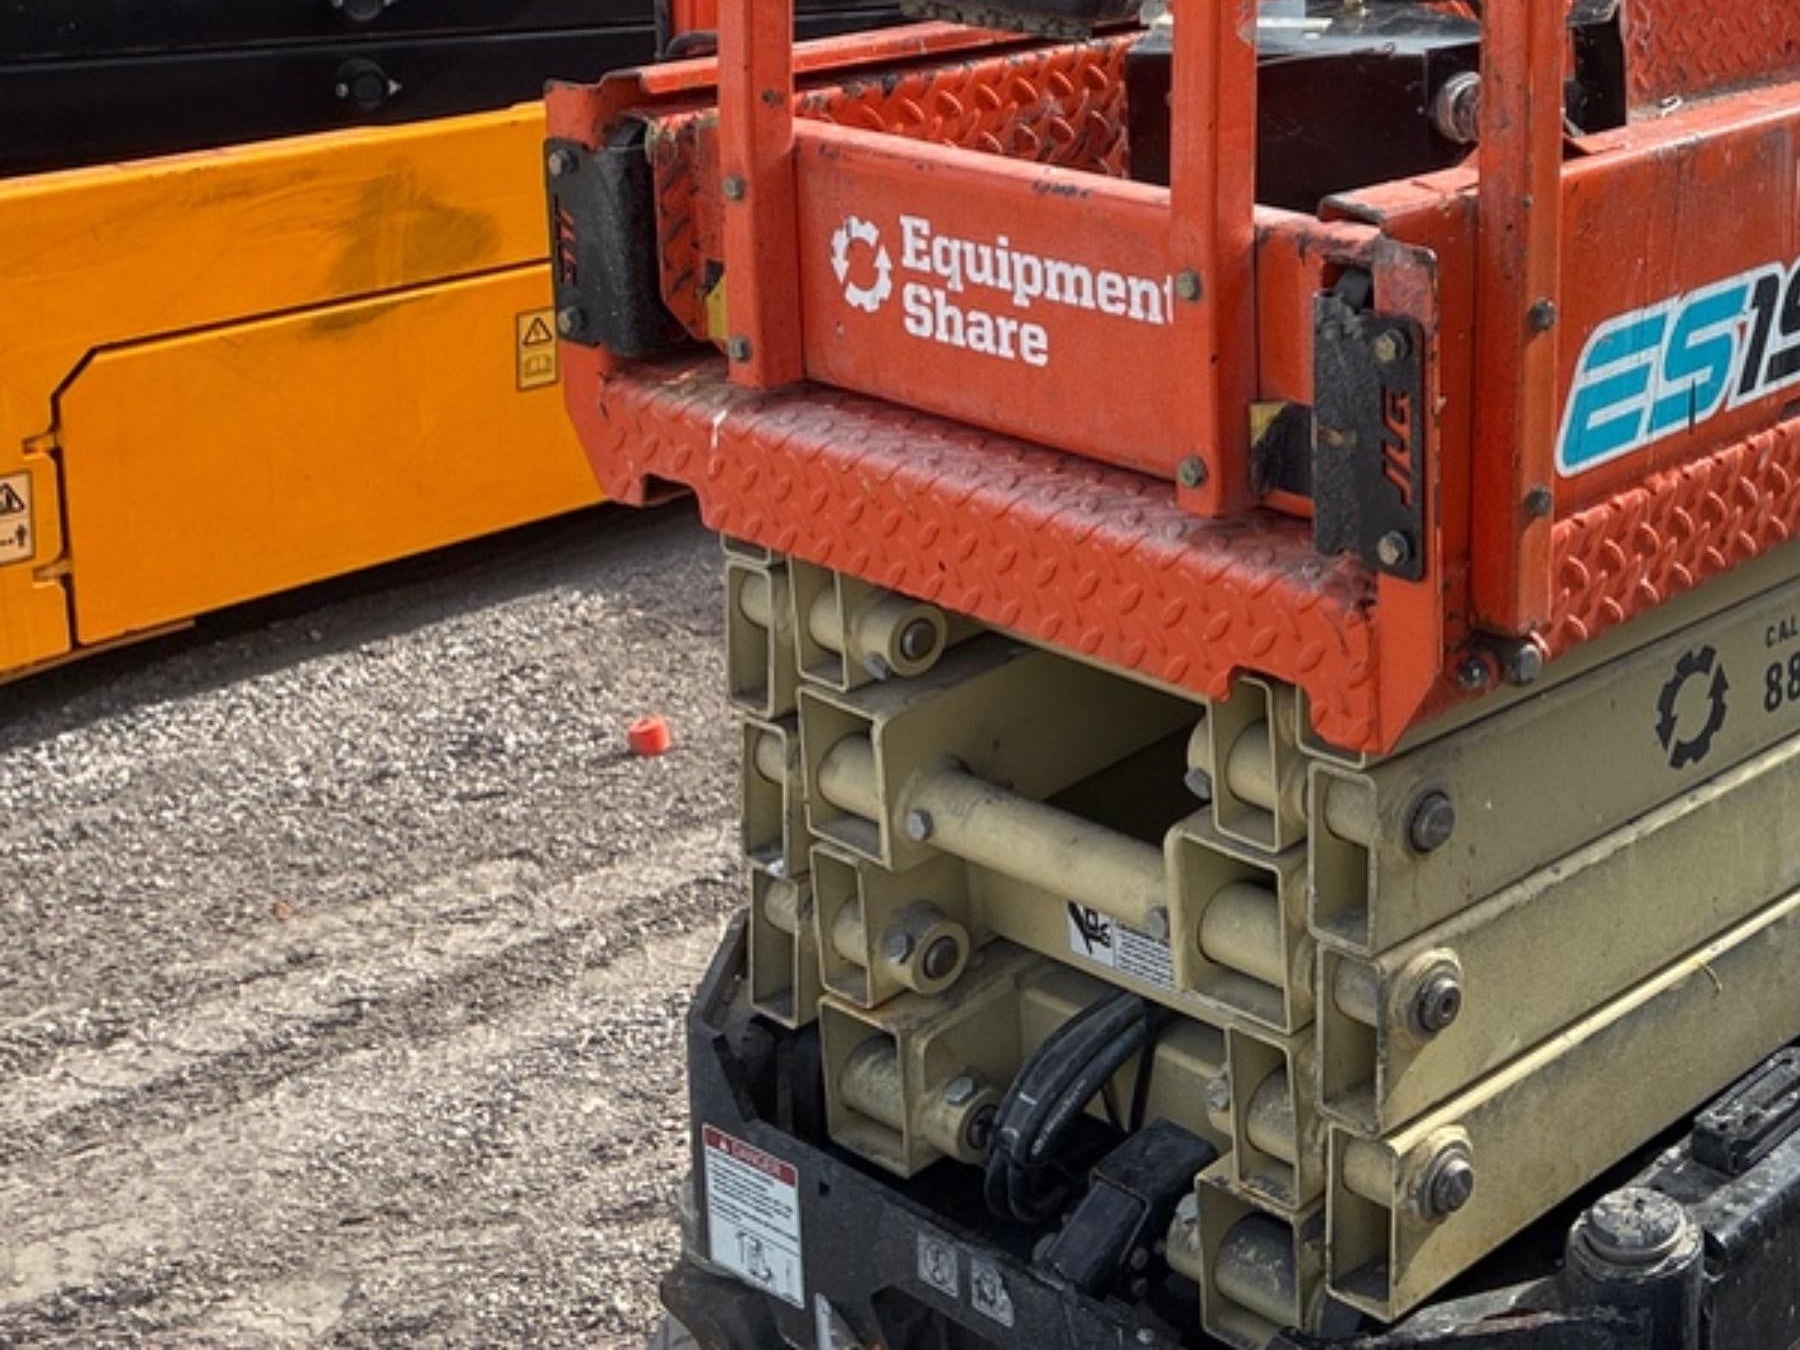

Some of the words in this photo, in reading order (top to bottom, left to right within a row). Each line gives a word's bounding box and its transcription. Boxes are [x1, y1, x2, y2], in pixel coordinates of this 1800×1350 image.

[899, 215, 1174, 325] Equipment
[902, 284, 1049, 367] Share
[1382, 387, 1413, 509] JLG
